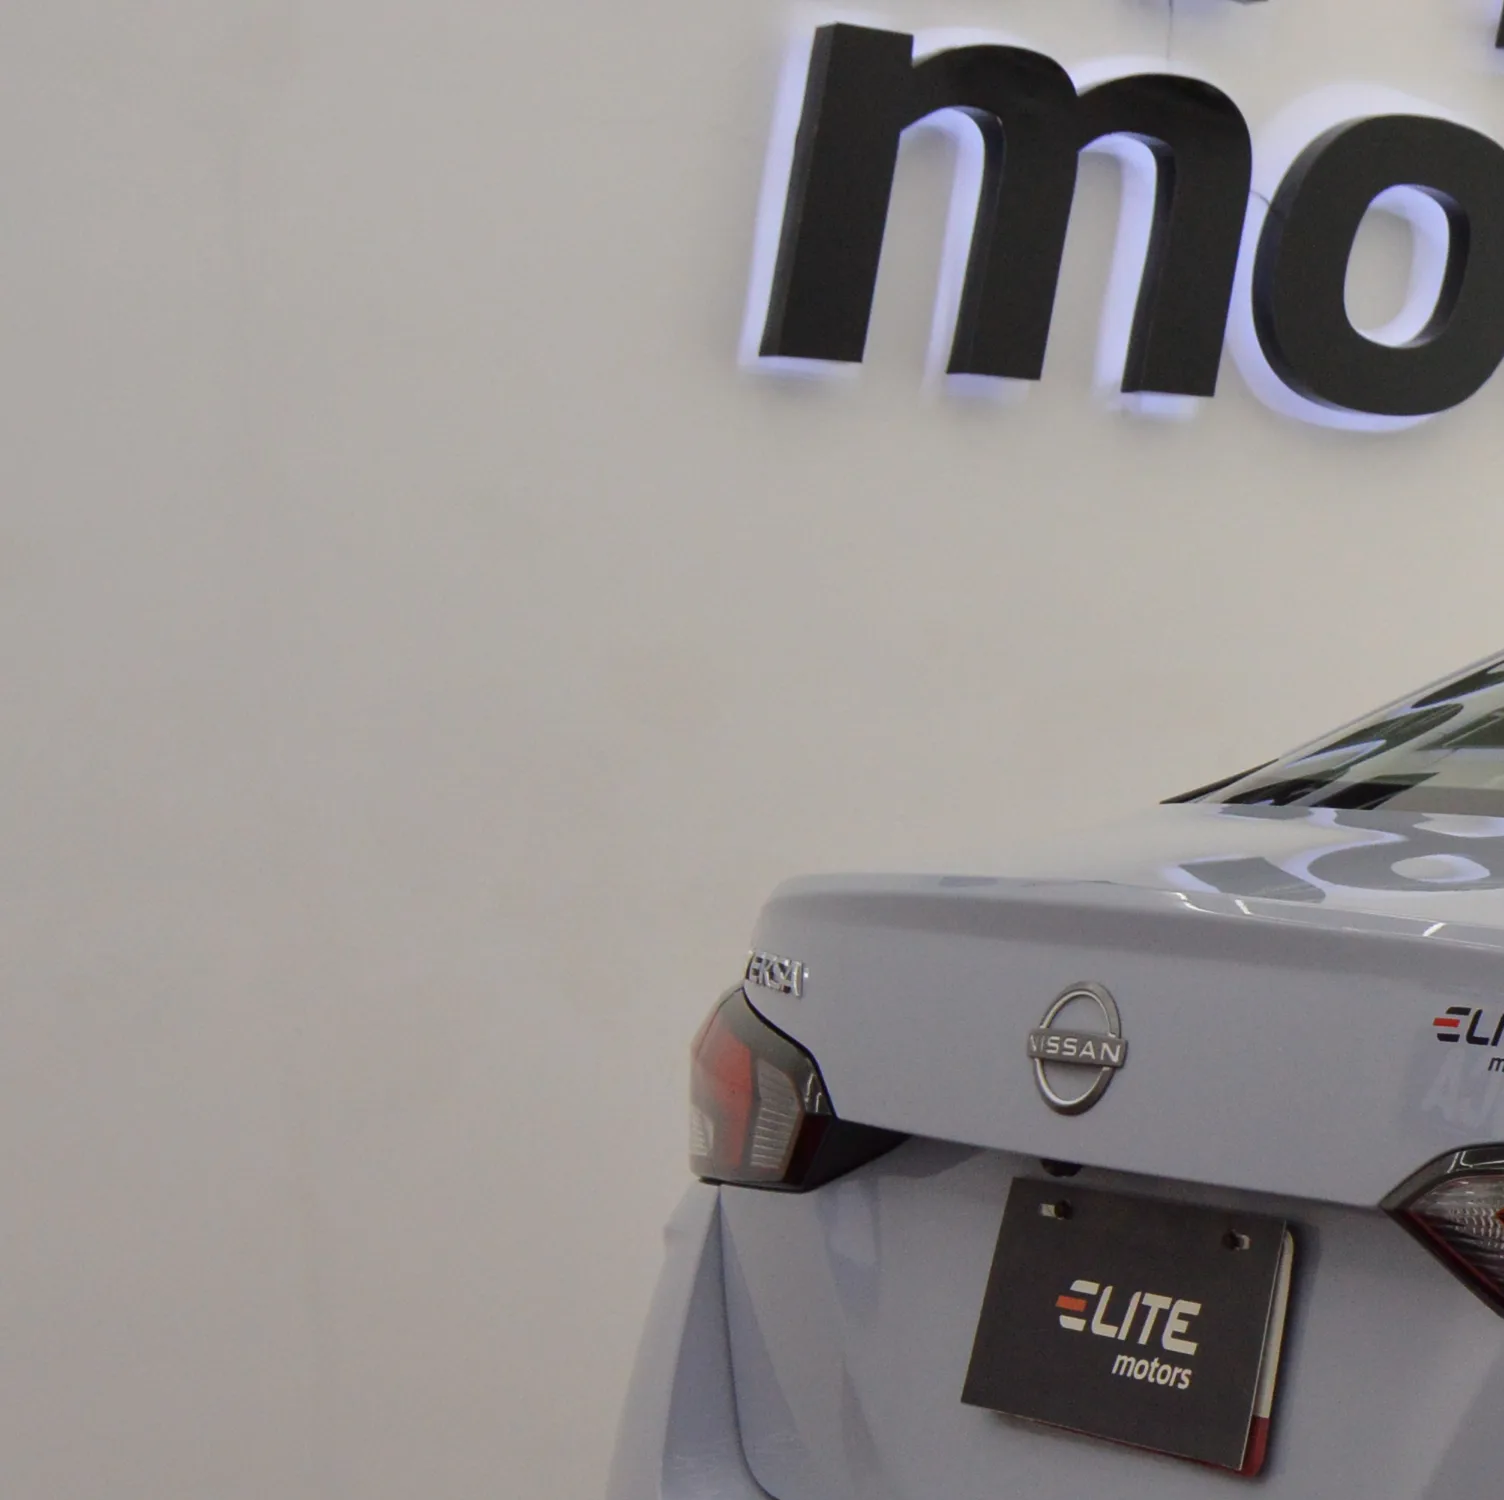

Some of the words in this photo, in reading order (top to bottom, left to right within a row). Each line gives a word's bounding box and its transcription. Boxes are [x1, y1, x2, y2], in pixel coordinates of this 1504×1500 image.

[1029, 1034, 1122, 1064] NISSAN
[1055, 1279, 1202, 1356] ELITE
[1111, 1354, 1193, 1390] motors
